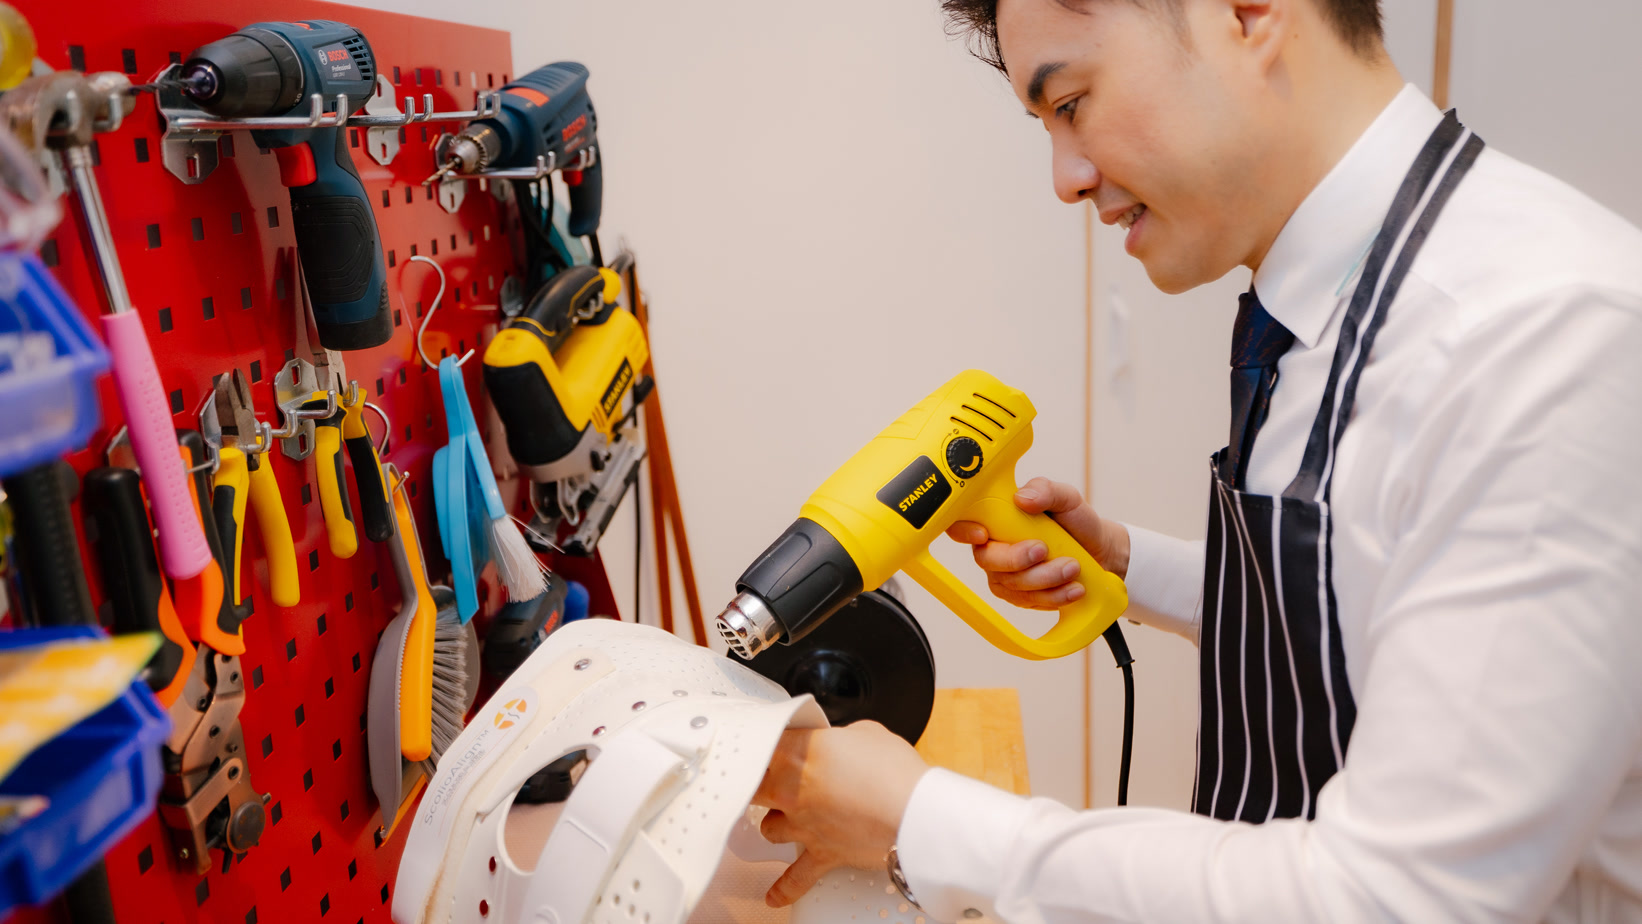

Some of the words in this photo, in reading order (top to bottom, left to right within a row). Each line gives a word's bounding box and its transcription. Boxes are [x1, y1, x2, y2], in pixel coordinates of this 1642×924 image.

[327, 49, 349, 62] BOSCH
[603, 364, 631, 413] STANLEY
[898, 473, 938, 512] STANLEY
